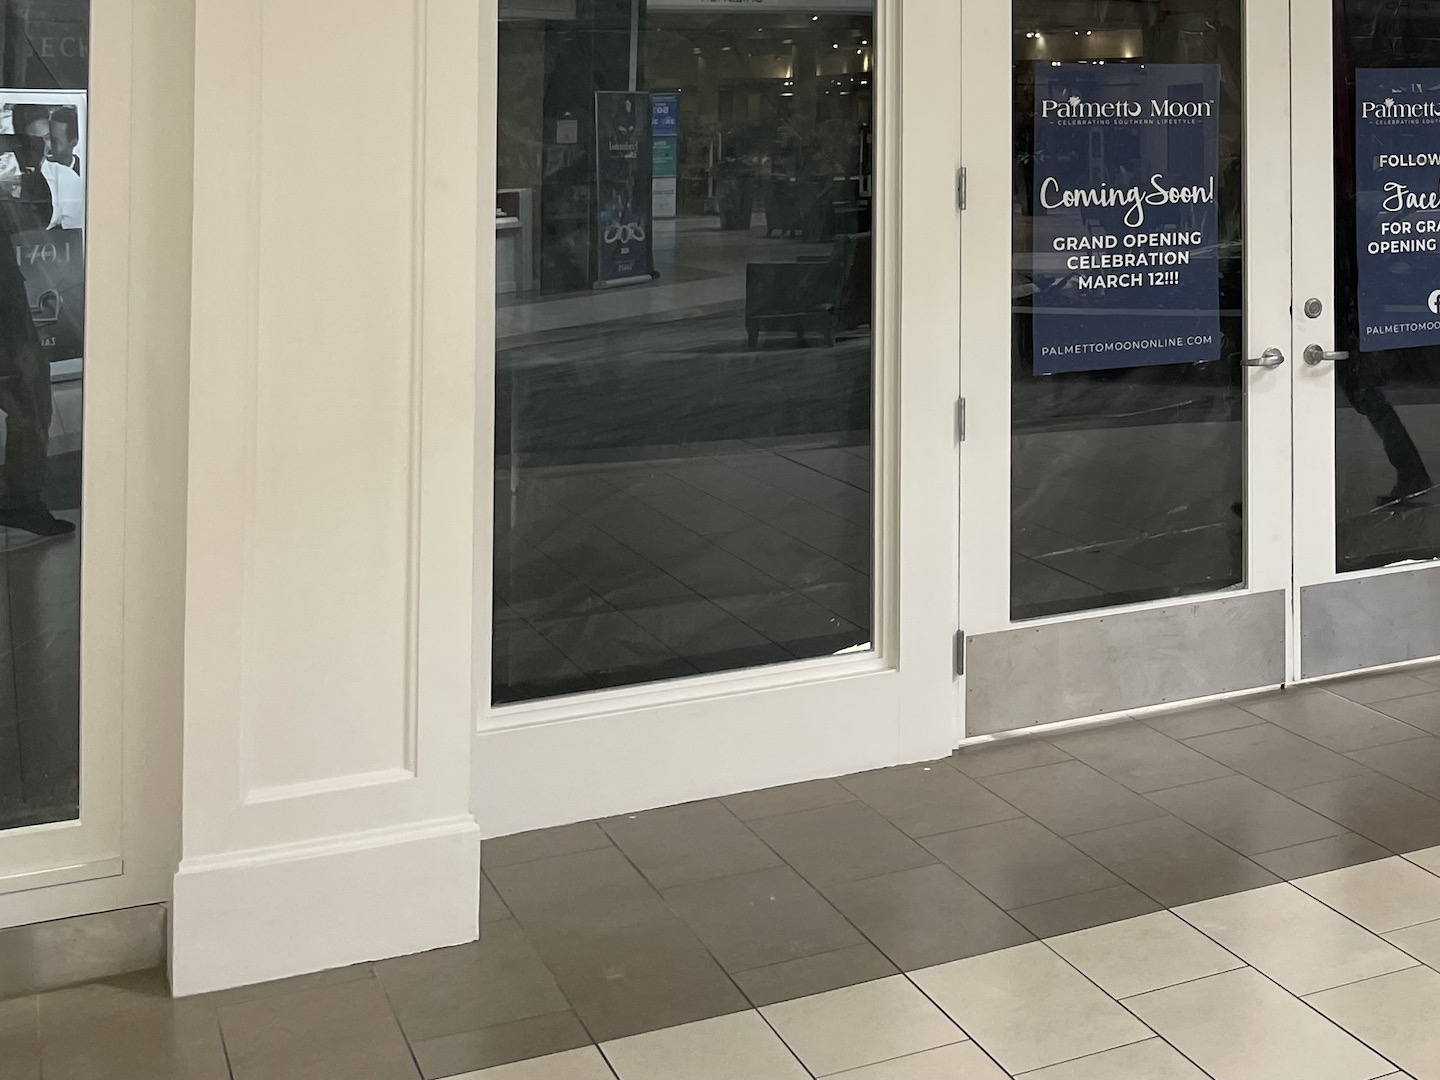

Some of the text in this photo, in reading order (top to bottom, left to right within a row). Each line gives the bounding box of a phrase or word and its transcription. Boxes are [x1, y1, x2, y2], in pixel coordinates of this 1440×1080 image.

[1041, 95, 1142, 118] Palmetto
[1156, 118, 1196, 126] LIFESTYLE
[1039, 173, 1214, 228] Coming Soon!
[1381, 222, 1412, 236] FOR
[1053, 231, 1202, 251] GRAND OPENING
[1367, 238, 1437, 255] OPENING
[1066, 250, 1190, 271] CELEBRATION
[1078, 271, 1179, 290] MARCH 12!!!
[1041, 335, 1213, 357] PALMETTOMOONONLINE.COM
